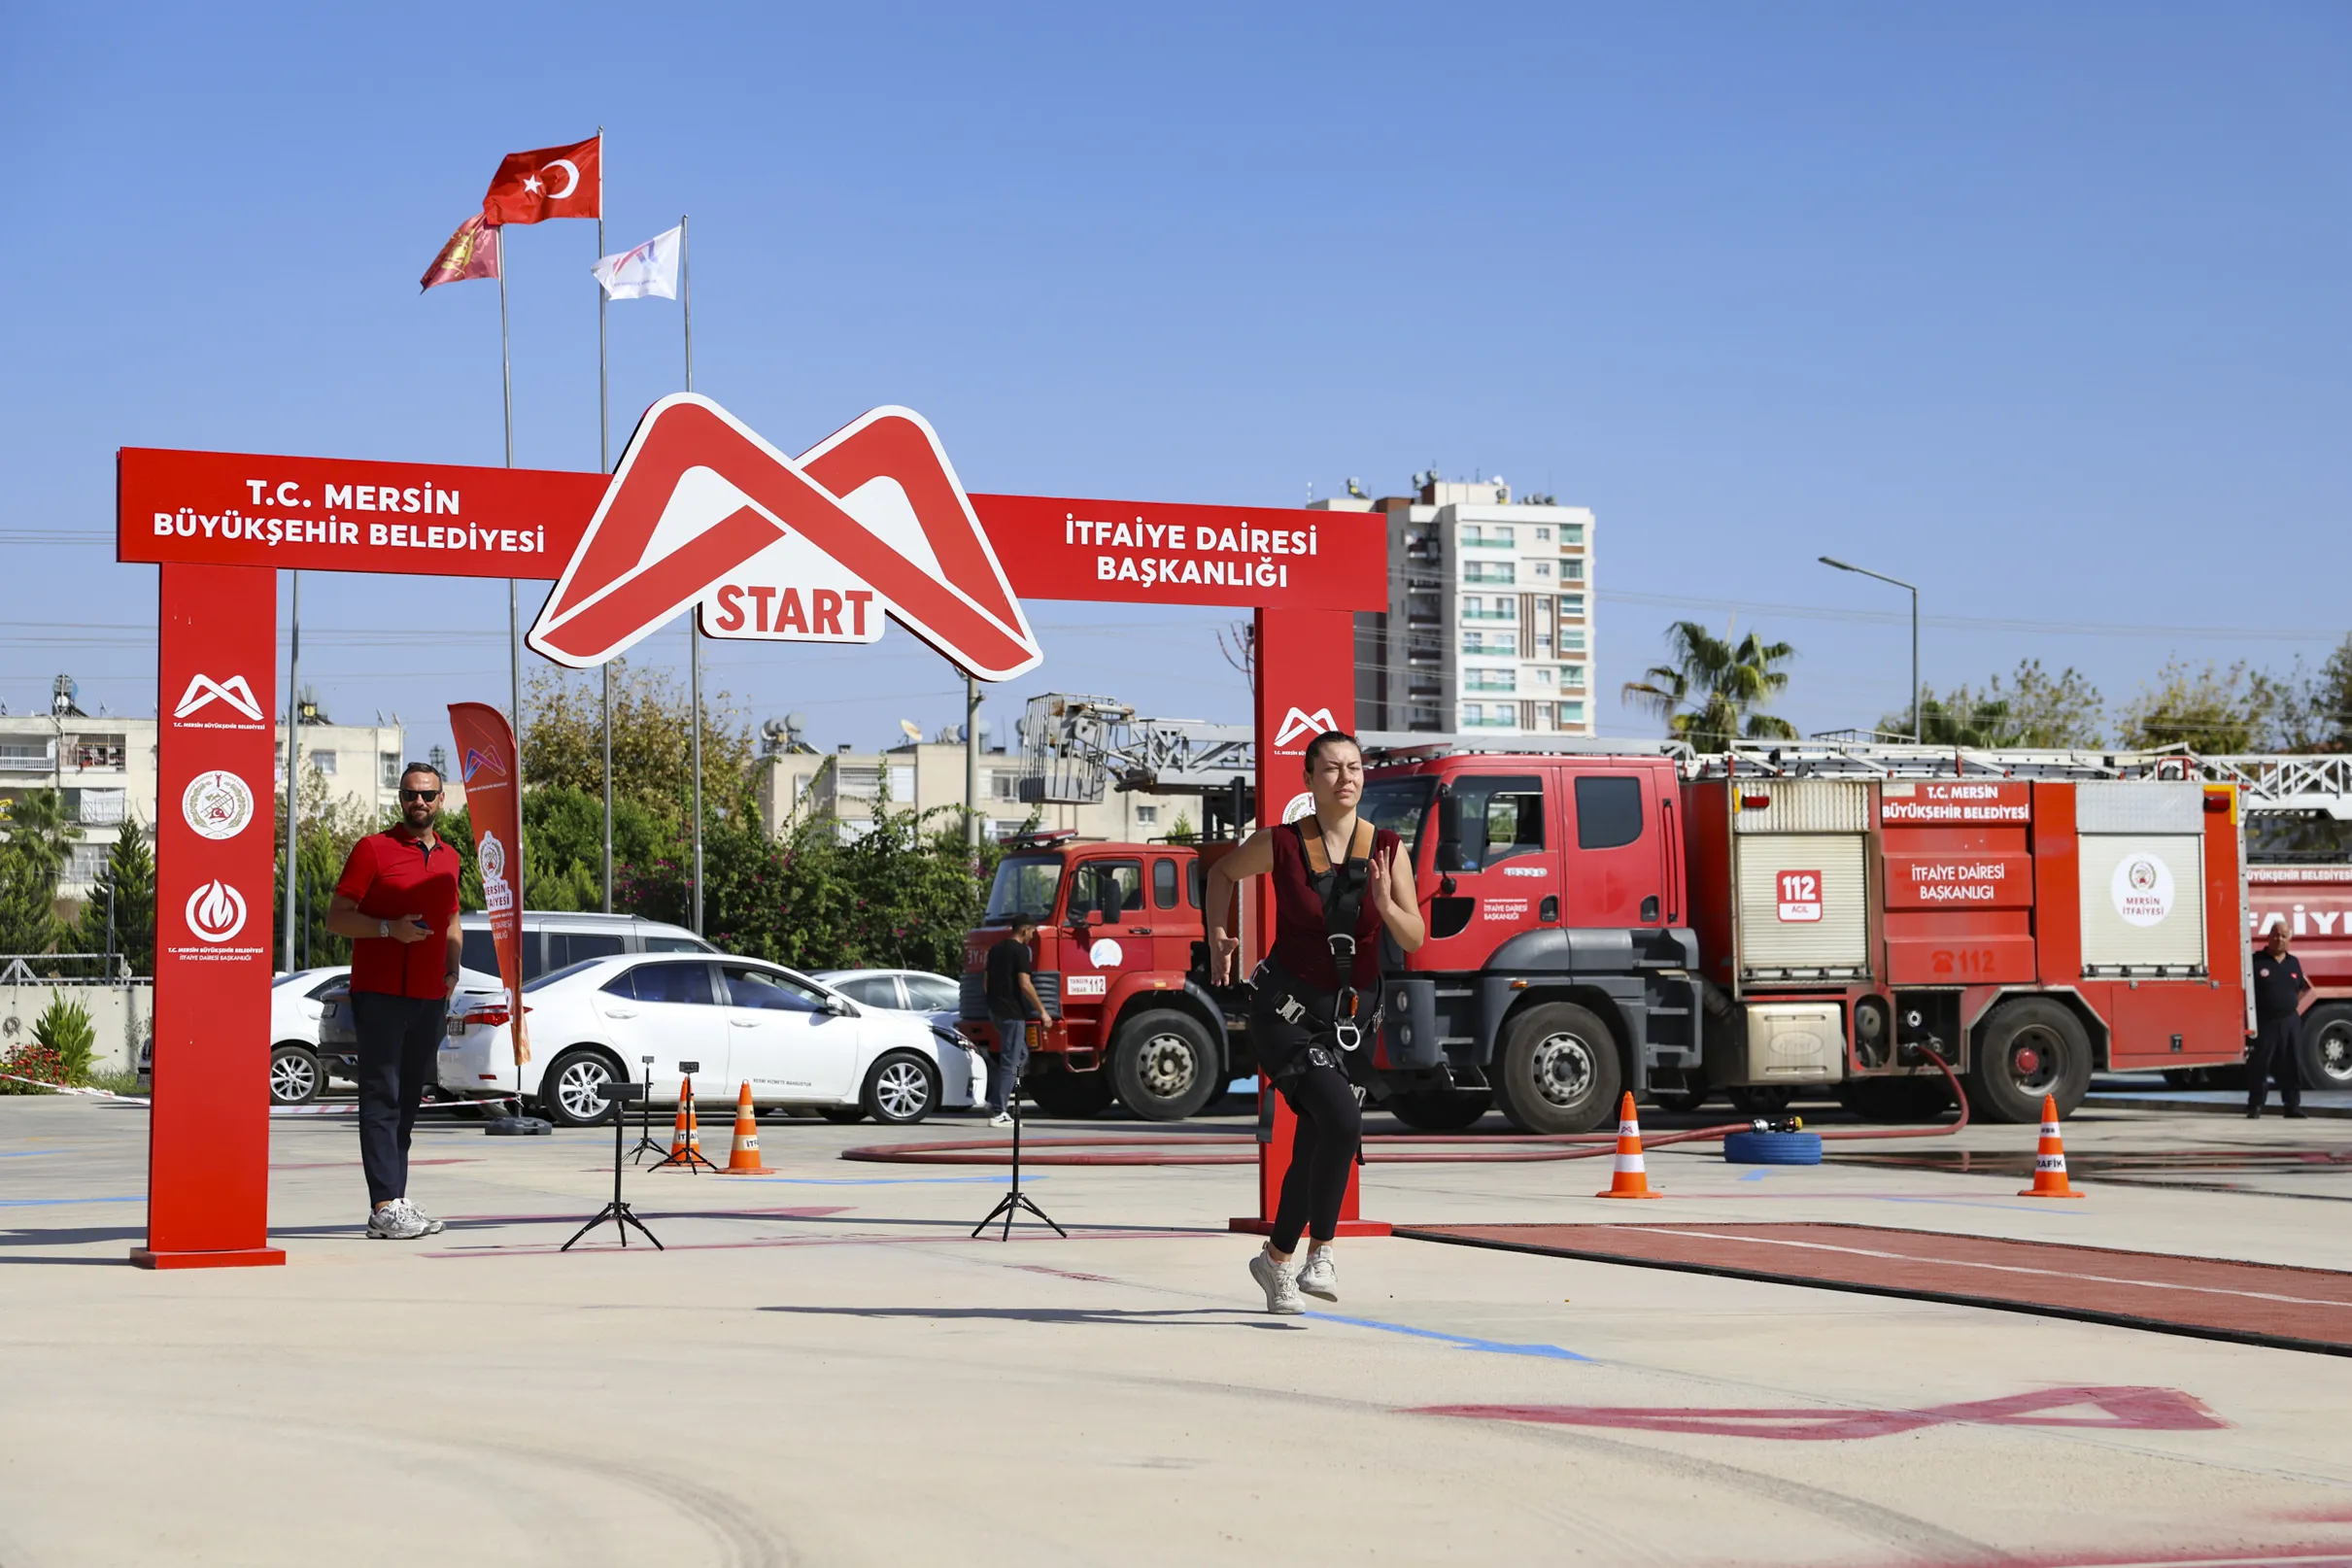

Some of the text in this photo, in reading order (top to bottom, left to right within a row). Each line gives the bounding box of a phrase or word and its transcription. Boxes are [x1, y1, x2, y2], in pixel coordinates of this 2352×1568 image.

[246, 479, 460, 516] T.C. MERSİN
[153, 507, 544, 553] BÜYÜKŞEHİR BELEDİYESİ
[1066, 513, 1317, 556] İTFAİYE DAİRESİ
[1097, 556, 1287, 588] BAŞKANLIĞI
[715, 584, 873, 636] START
[1926, 784, 1998, 799] T.C. MERSİN
[1882, 802, 2029, 820] BÜYÜKŞEHİR BELEDİYESİ
[1911, 864, 1956, 881] İTFAİYE
[1958, 862, 2005, 880] DAİRESİ
[2247, 869, 2301, 883] ÜYÜKŞEHİR
[1782, 875, 1817, 901] 112
[2126, 896, 2161, 905] MERSİN
[2123, 905, 2165, 916] İTFAİYESİ
[1959, 949, 1995, 972] 112
[1089, 978, 1105, 992] 112
[2036, 1158, 2063, 1168] RAFİK
